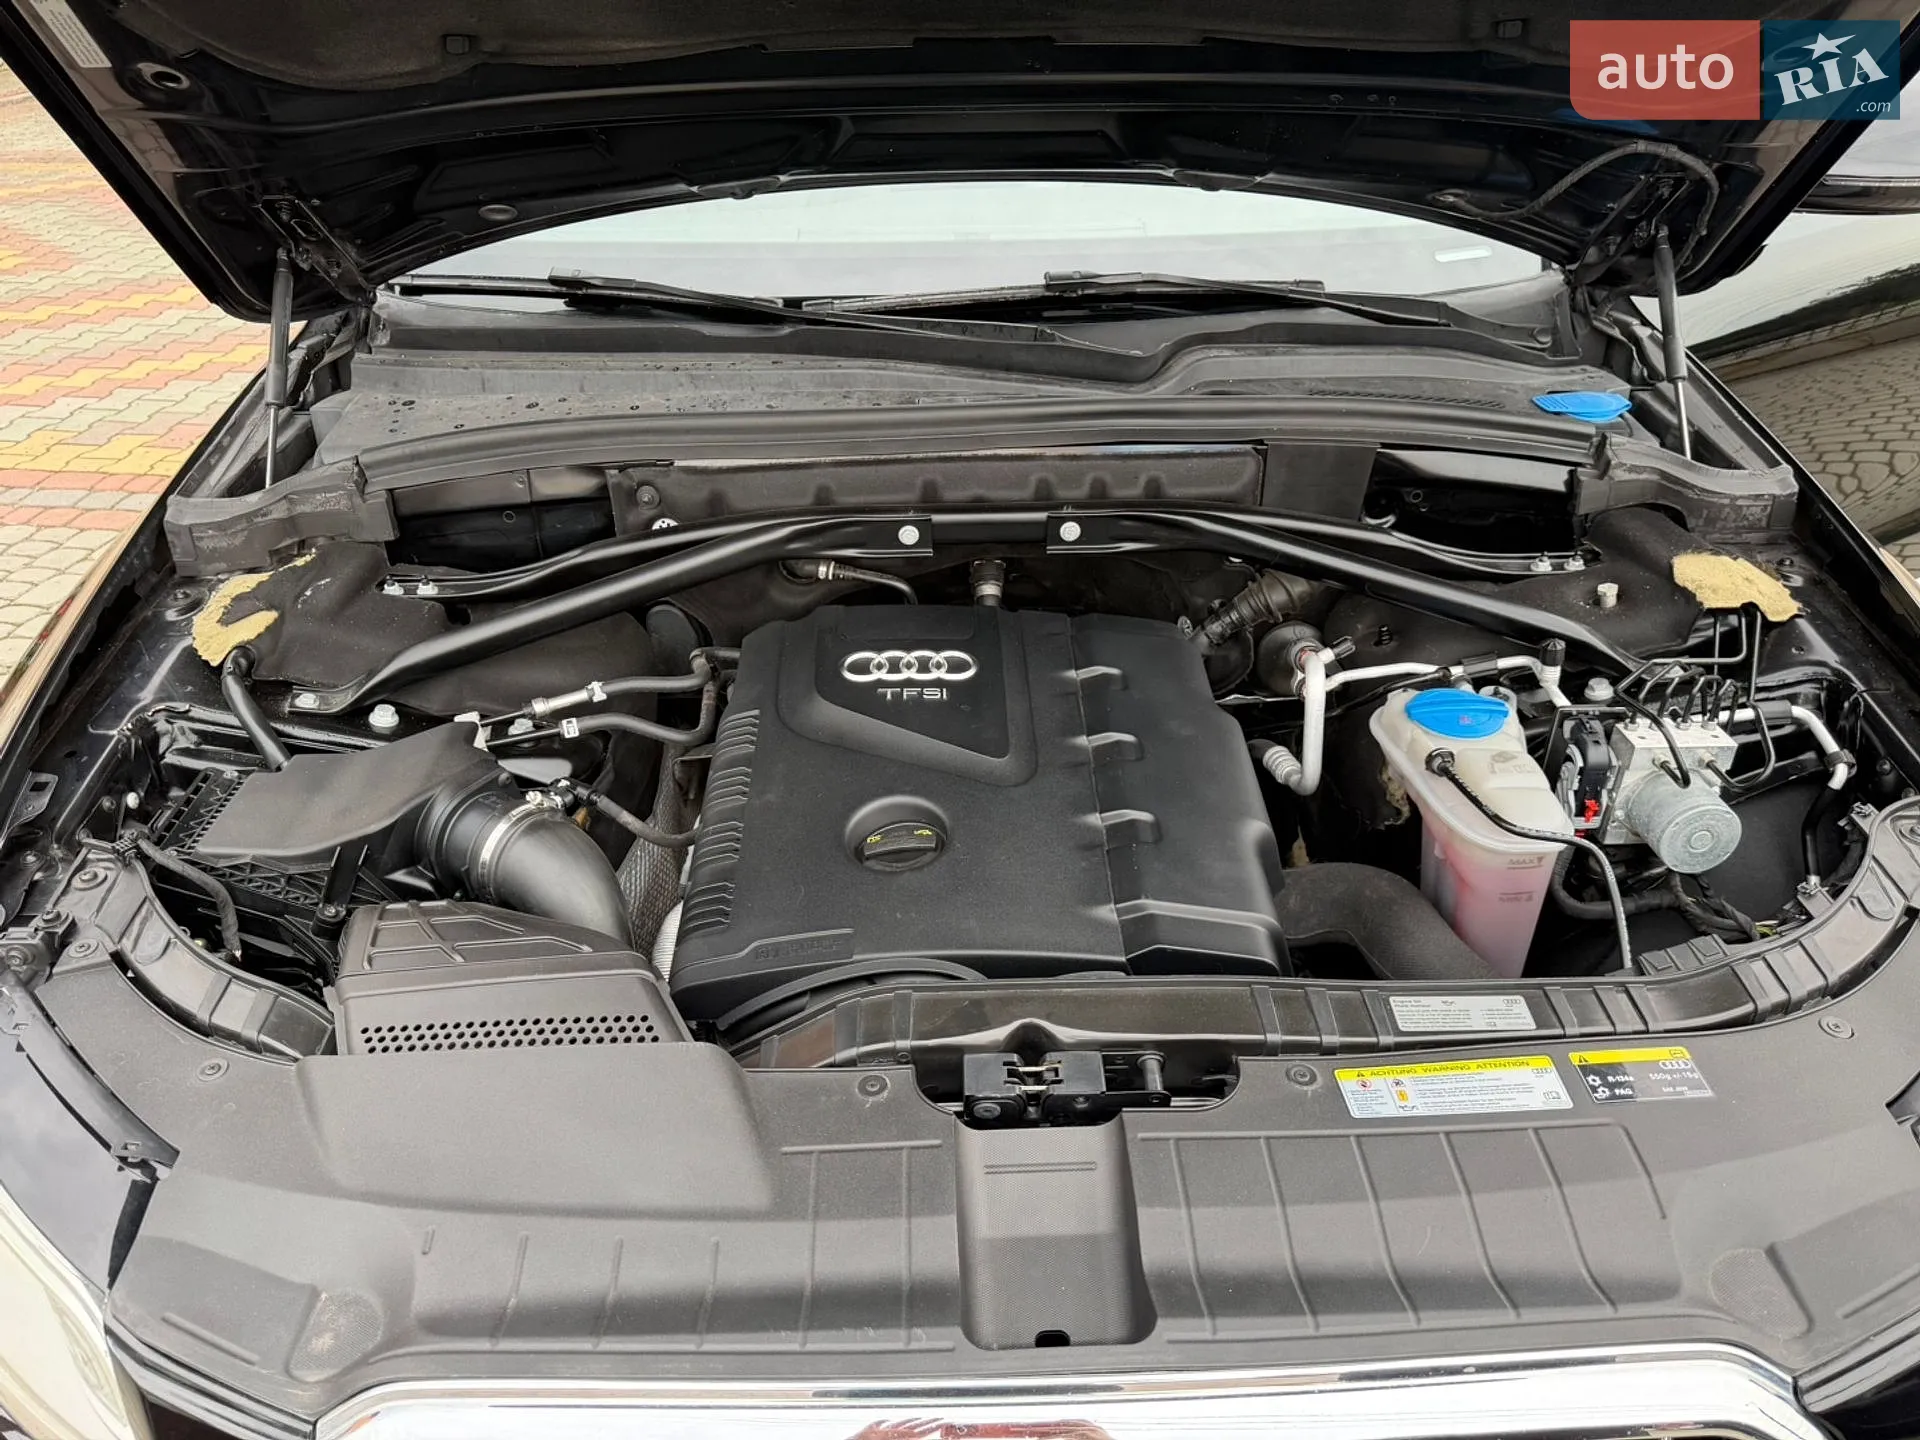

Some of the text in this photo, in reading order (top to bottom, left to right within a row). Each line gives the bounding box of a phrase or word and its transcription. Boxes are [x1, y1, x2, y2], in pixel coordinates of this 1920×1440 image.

[877, 687, 948, 700] TFSI
[1370, 1060, 1530, 1077] ACHTUNG WARNING ATTENTION
